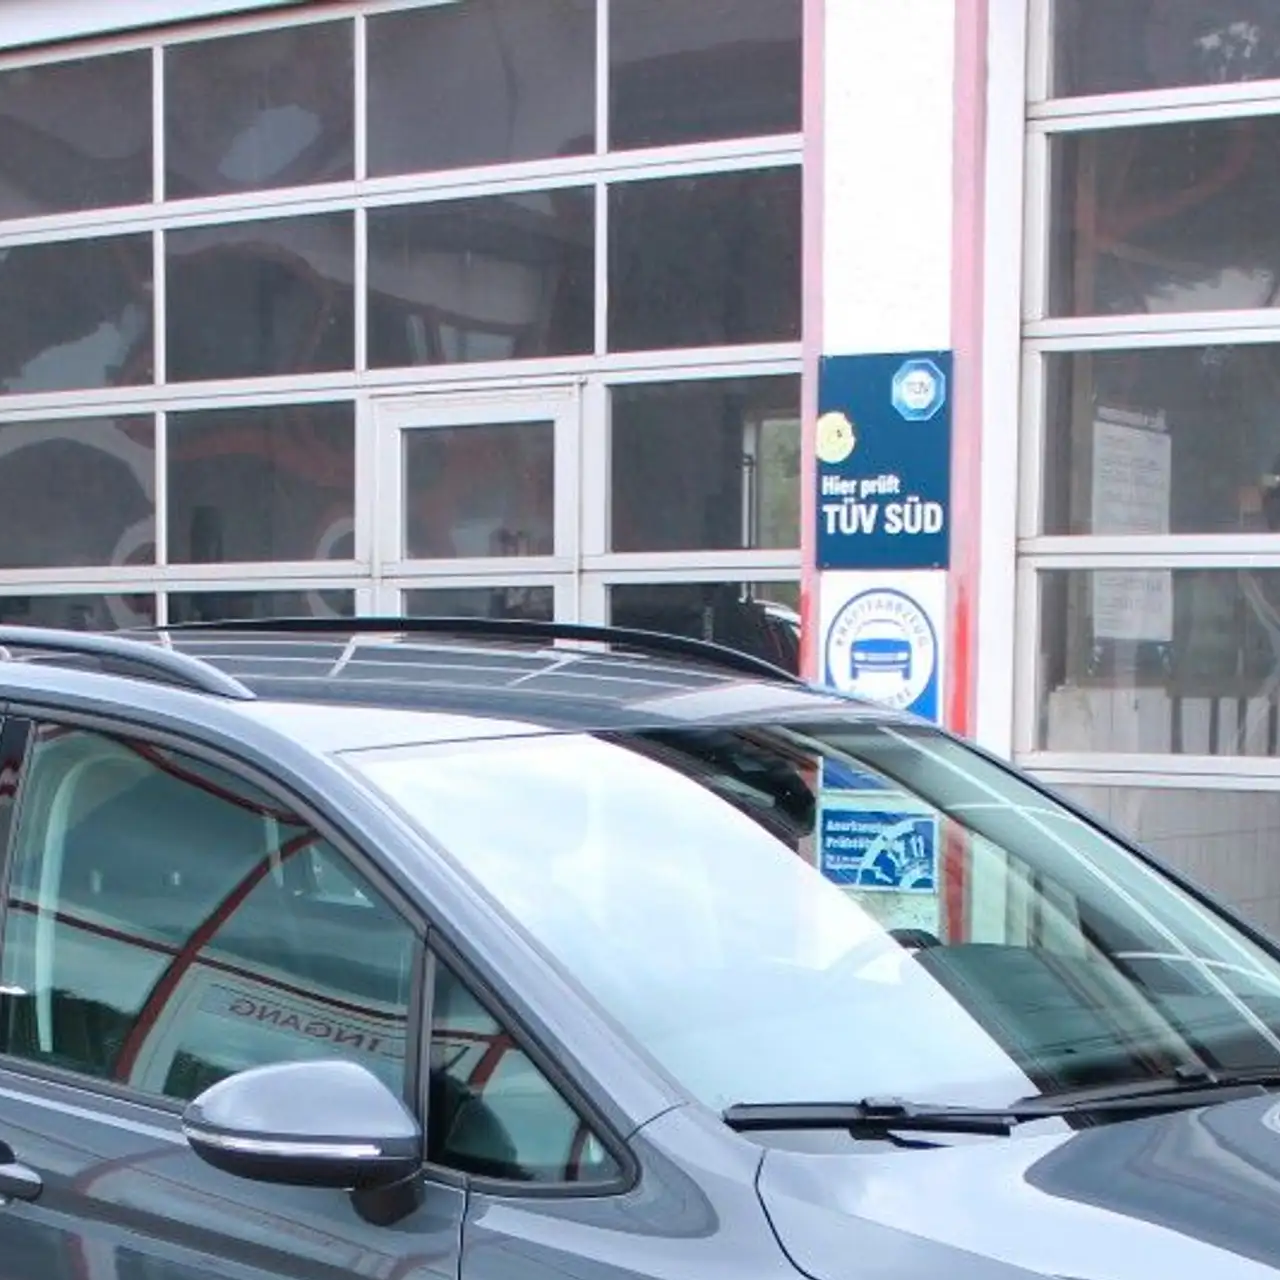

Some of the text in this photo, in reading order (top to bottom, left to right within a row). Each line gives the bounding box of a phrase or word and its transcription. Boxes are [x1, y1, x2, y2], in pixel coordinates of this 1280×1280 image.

[822, 474, 900, 499] Hier prüft
[822, 495, 943, 535] TÜV SÜD
